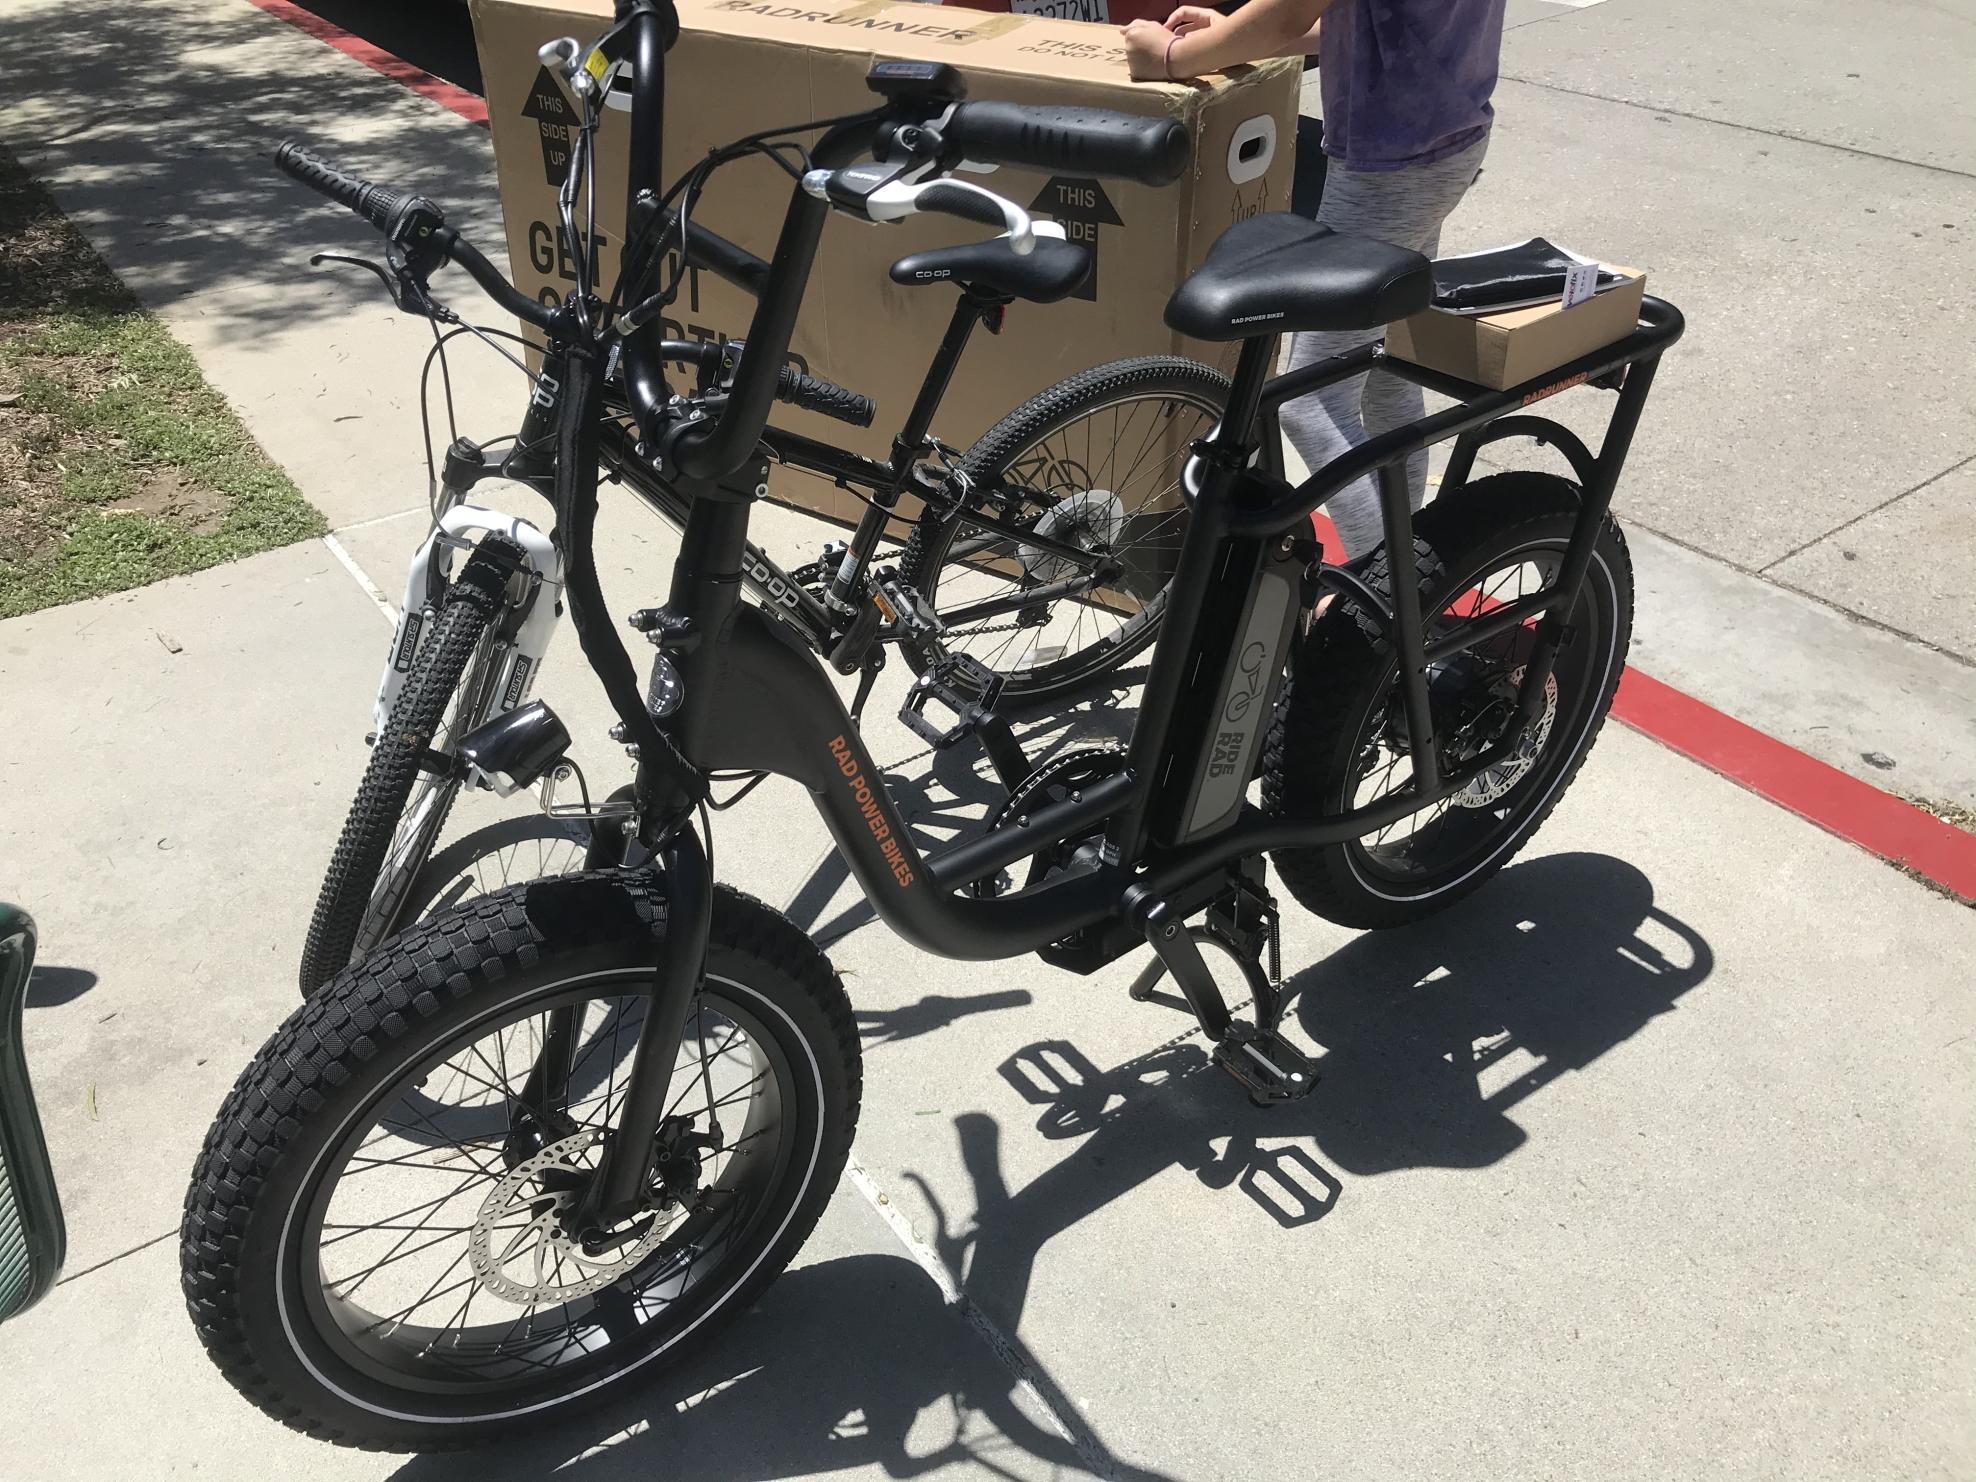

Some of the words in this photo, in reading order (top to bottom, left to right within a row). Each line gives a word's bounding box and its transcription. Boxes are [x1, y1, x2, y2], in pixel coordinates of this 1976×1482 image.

[717, 0, 977, 40] RADRUNNER
[1038, 39, 1102, 52] THIS
[1054, 50, 1103, 60] NOT
[536, 94, 563, 113] THIS
[541, 122, 568, 141] SIDE
[549, 149, 566, 166] UP
[1056, 185, 1096, 208] THIS
[528, 220, 608, 288] GET
[1244, 314, 1267, 322] POWER
[1522, 371, 1589, 406] RADRUNNER
[1208, 732, 1233, 778] RAD
[1221, 732, 1245, 775] RIDE
[828, 735, 858, 777] RAD
[848, 774, 890, 841] POWER
[880, 836, 914, 888] BIKES
